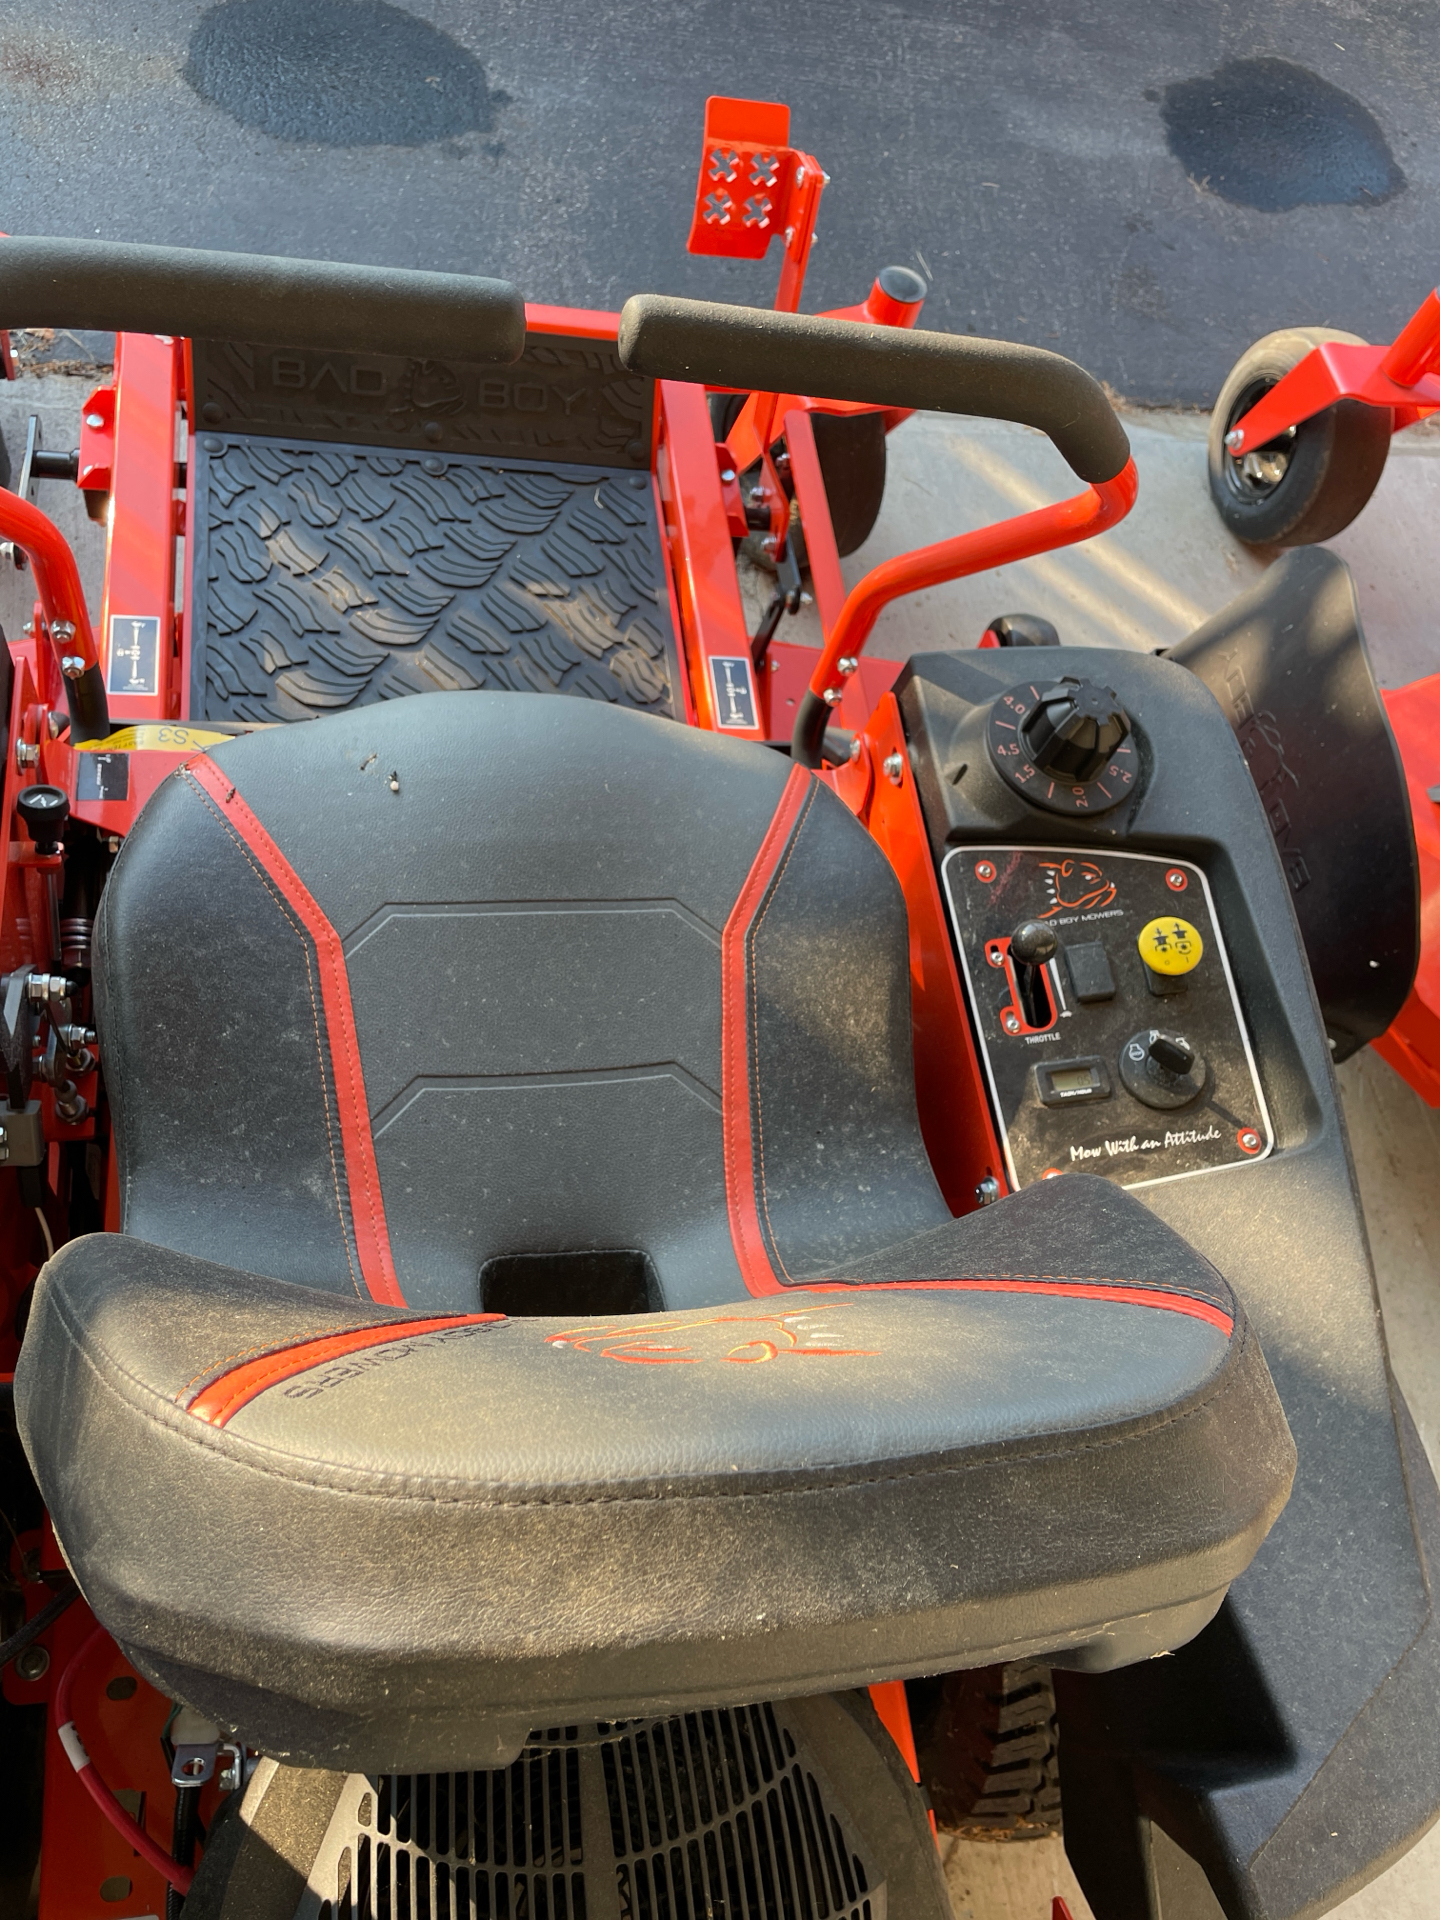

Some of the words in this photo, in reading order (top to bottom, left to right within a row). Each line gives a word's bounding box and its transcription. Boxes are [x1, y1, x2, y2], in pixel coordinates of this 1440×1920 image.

[271, 355, 388, 397] BAD
[478, 377, 588, 417] BOY
[1003, 695, 1026, 715] 4.0
[997, 743, 1020, 756] 4.5
[1014, 764, 1036, 784] 1.5
[1108, 765, 1133, 784] 2.5
[1071, 786, 1089, 808] 2.0
[1060, 916, 1079, 926] BOY
[1081, 909, 1124, 922] MOWERS
[1025, 1032, 1062, 1045] THROTTLE
[1069, 1145, 1102, 1162] Mow
[1104, 1135, 1140, 1157] With
[1140, 1139, 1162, 1150] an
[1164, 1125, 1222, 1149] Attitude
[282, 1340, 435, 1400] MOWERS
